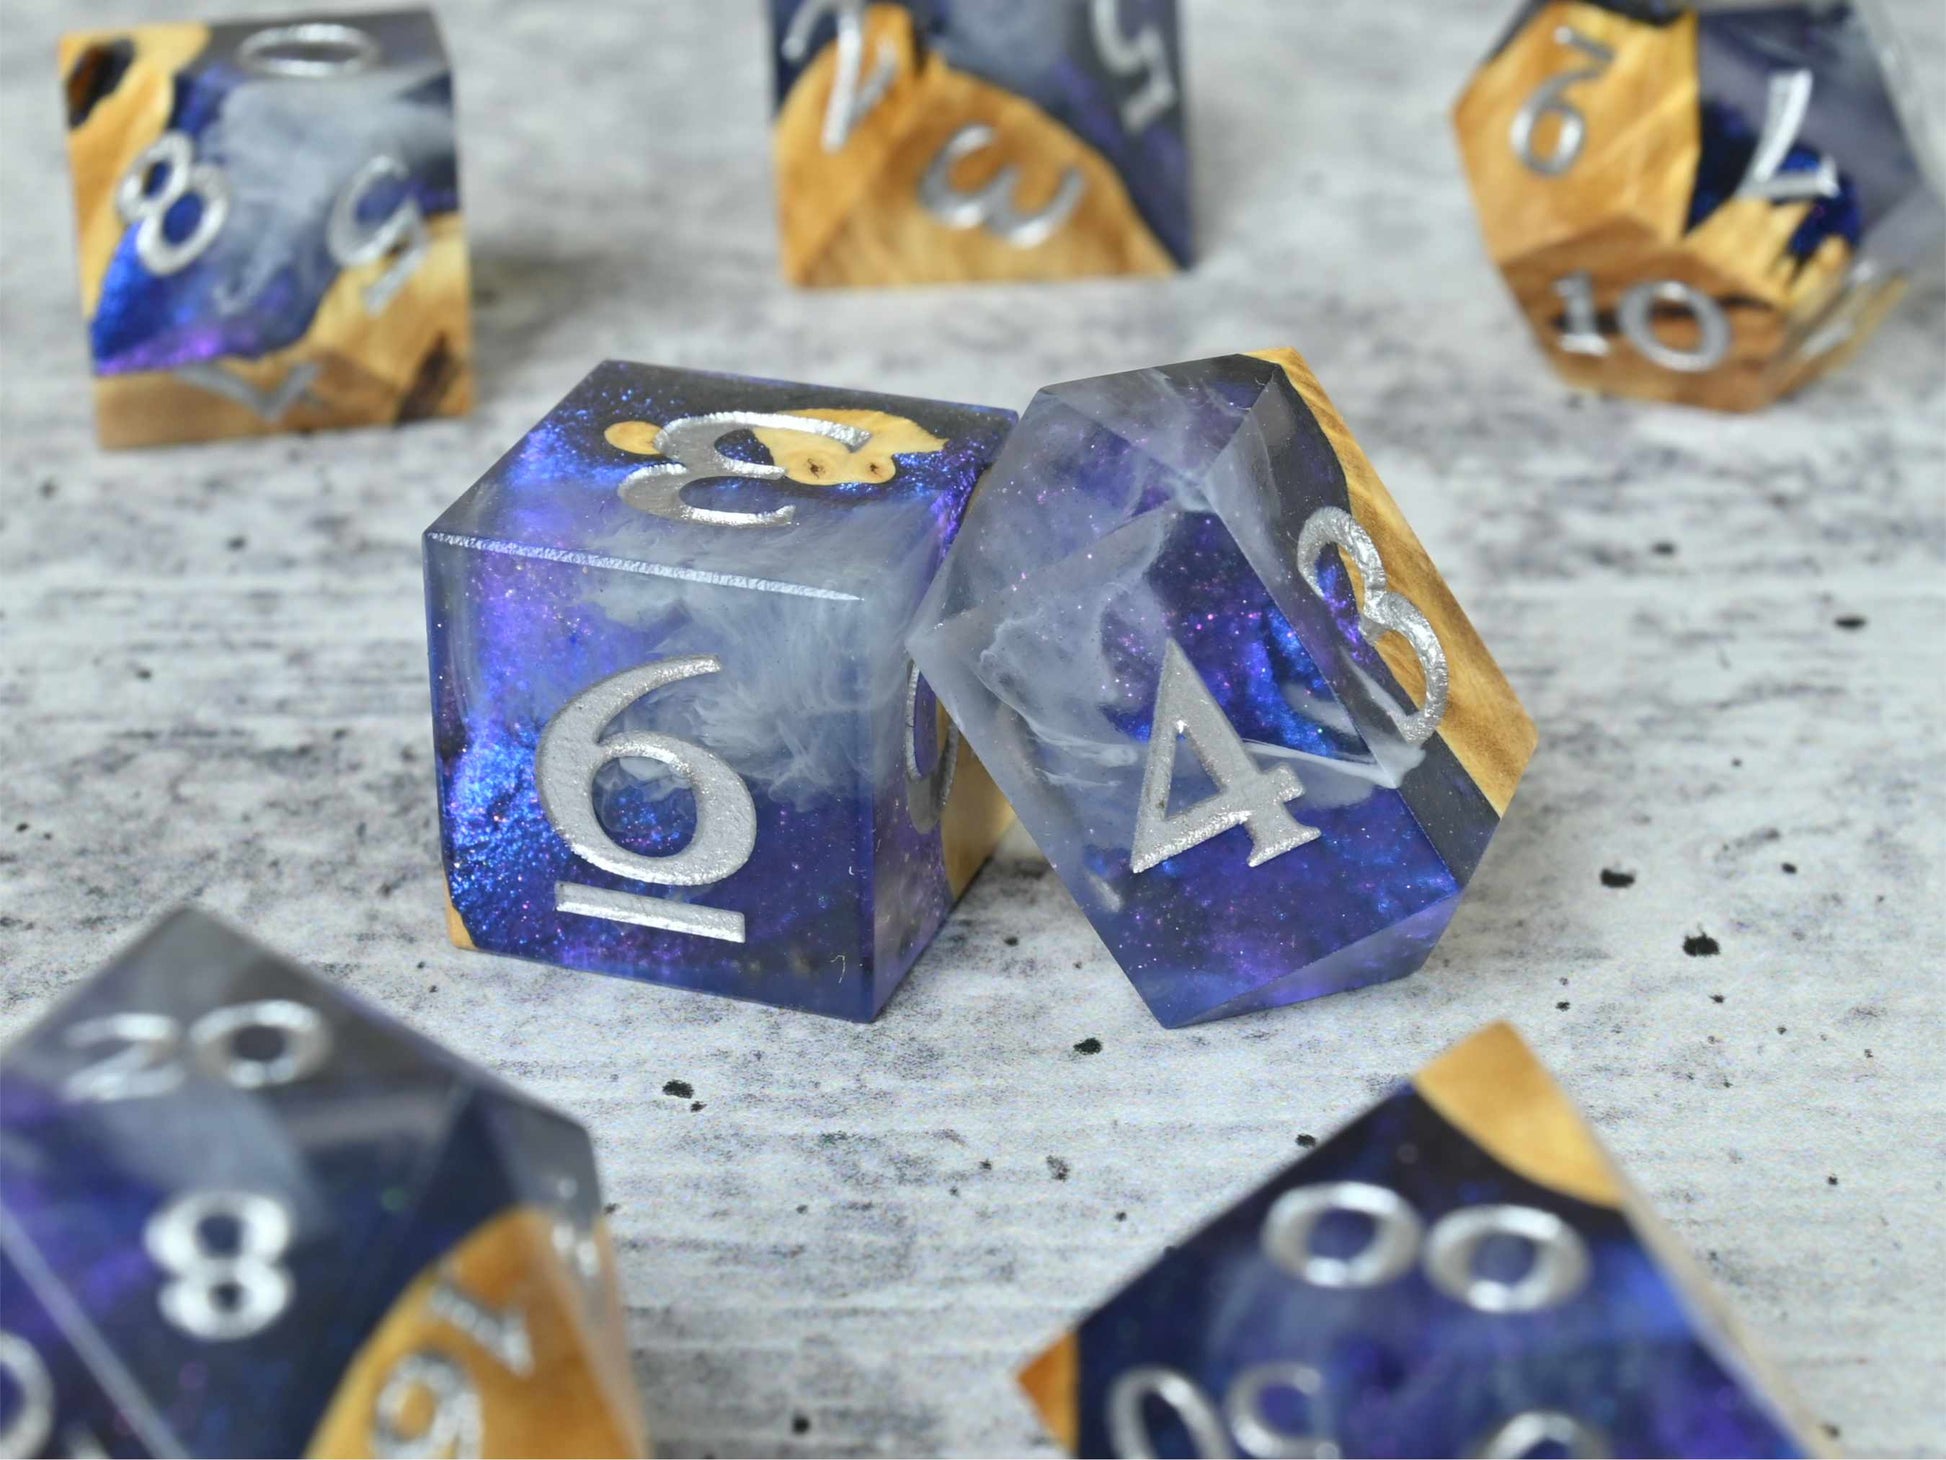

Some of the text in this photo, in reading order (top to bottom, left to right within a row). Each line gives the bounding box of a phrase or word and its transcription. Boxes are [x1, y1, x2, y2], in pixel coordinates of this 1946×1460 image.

[116, 131, 232, 276] 8
[917, 122, 1091, 250] 3
[1551, 270, 1732, 373] 10
[617, 410, 870, 528] 3
[1297, 506, 1449, 743] 3
[534, 655, 757, 887] 6
[1131, 638, 1322, 873] 4
[64, 999, 330, 1101] 20
[143, 1191, 293, 1341] 8
[1261, 1181, 1592, 1315] 00
